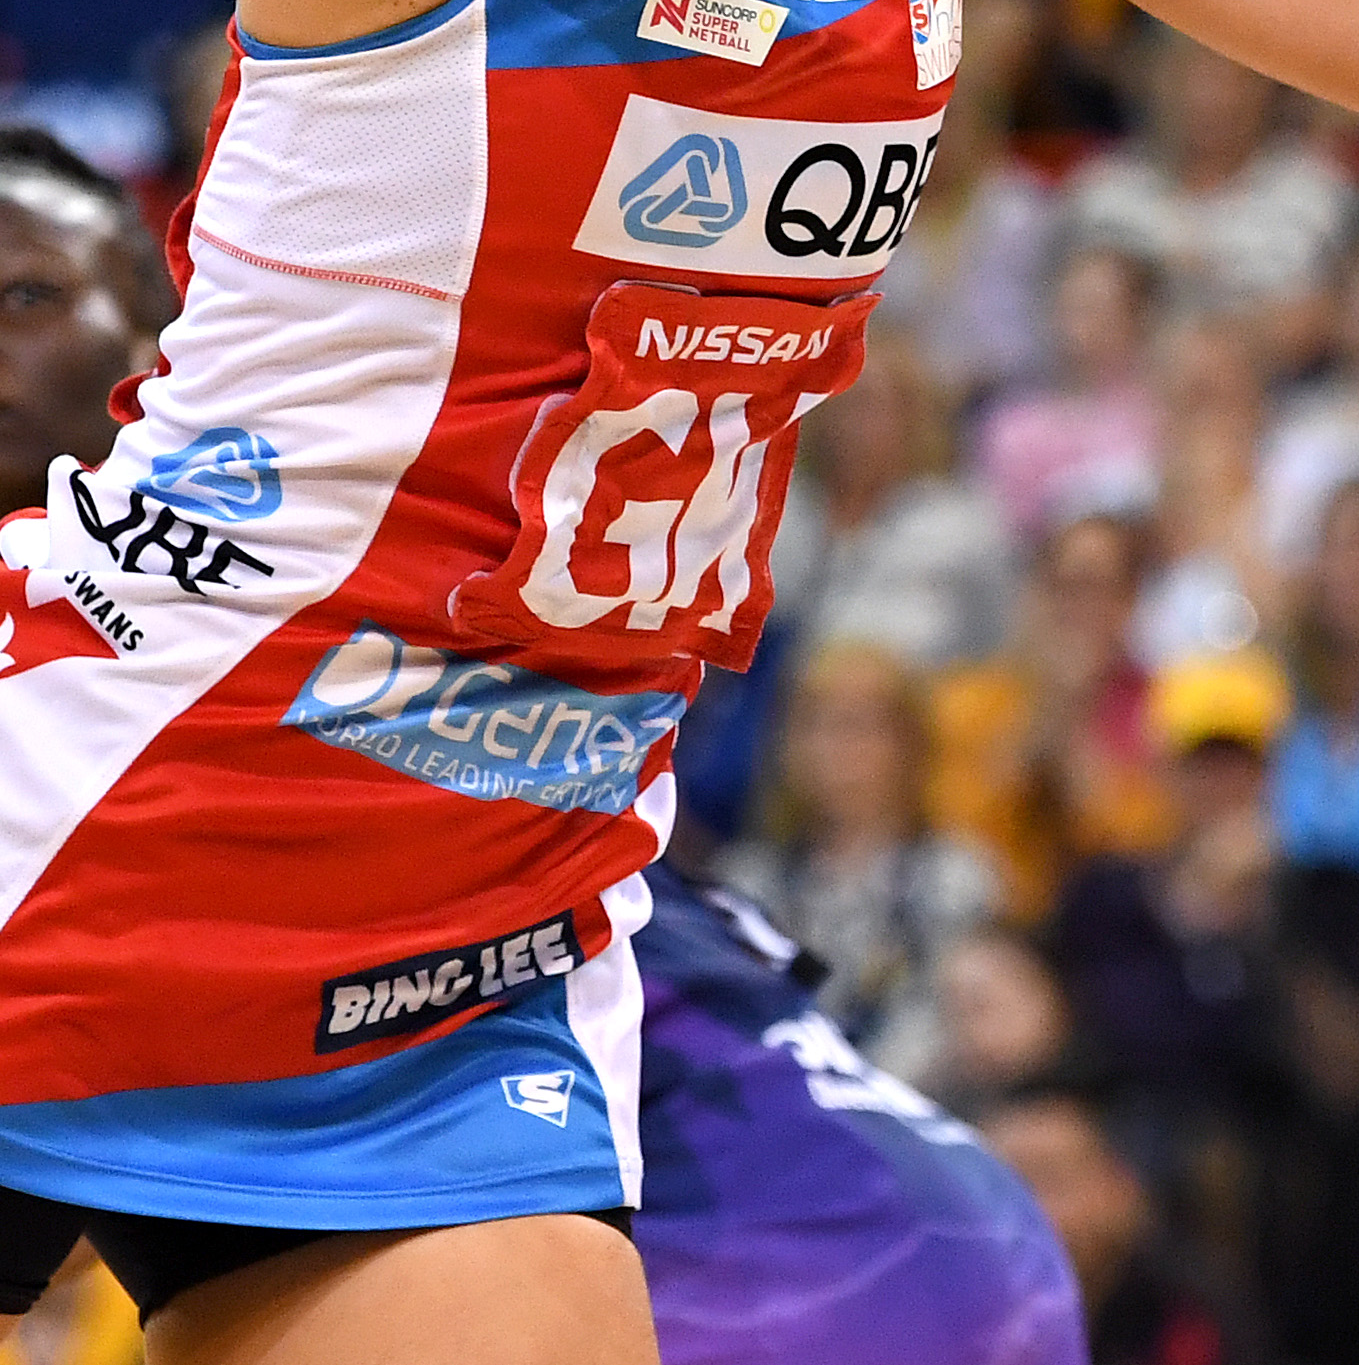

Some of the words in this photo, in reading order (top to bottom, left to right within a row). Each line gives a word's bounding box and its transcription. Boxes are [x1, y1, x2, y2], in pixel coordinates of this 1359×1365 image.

[688, 27, 751, 53] NETBALL
[691, 12, 739, 34] SUPER
[636, 318, 834, 364] NISSAN
[297, 709, 402, 758] ORLD
[328, 958, 474, 1034] BING
[478, 922, 575, 997] LEE
